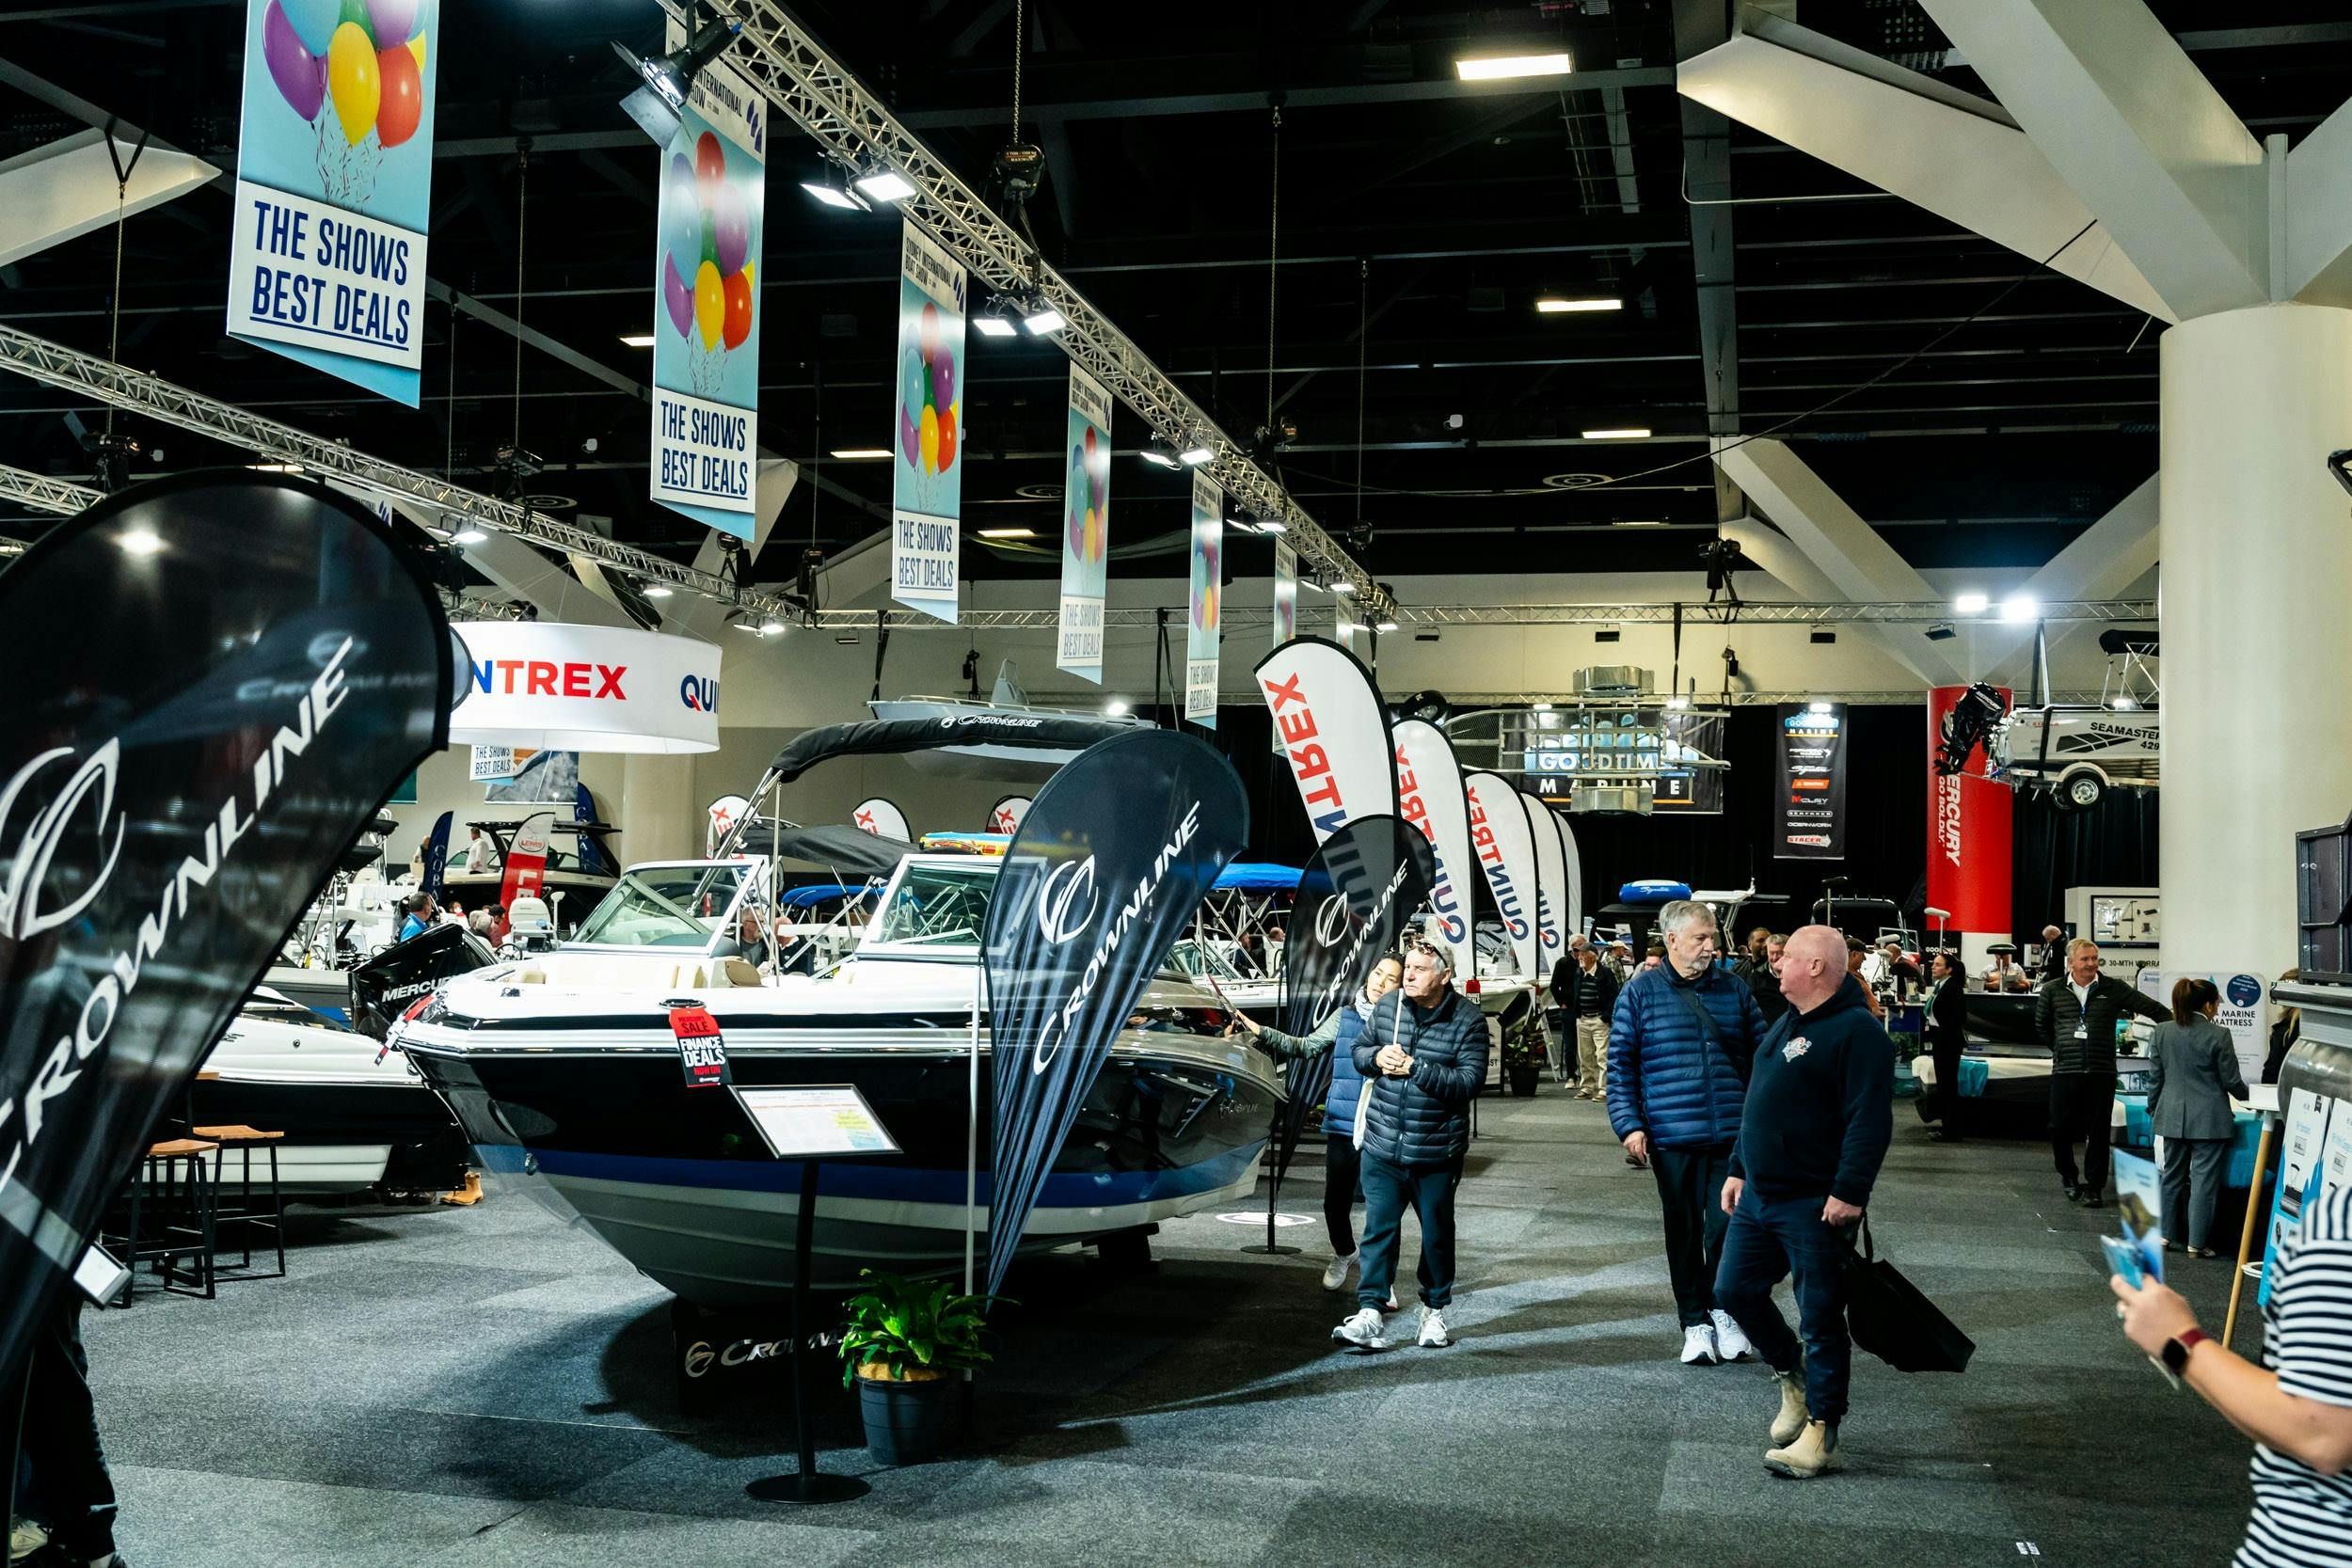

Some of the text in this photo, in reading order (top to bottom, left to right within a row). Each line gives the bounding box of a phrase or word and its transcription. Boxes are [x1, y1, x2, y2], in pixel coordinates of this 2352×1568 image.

[690, 82, 706, 109] HOW
[254, 200, 408, 286] THE SHOWS
[252, 265, 410, 344] BEST DEALS
[661, 400, 746, 451] THE SHOWS
[661, 447, 748, 496] BEST DEALS
[898, 519, 952, 553] THE SHOWS
[898, 556, 954, 588] BEST DEALS
[1065, 604, 1078, 626] THE
[1063, 633, 1082, 656] BEST
[470, 660, 628, 700] NTREX
[680, 674, 720, 715] QUI
[2139, 740, 2160, 751] 429
[475, 760, 512, 775] BEST DEALS
[1938, 776, 1946, 795] GO
[1946, 771, 1962, 868] ERCURY
[431, 845, 446, 901] COBA
[1033, 800, 1200, 1076] CROWNLINE
[1312, 858, 1408, 1029] CROWNLINE
[2135, 959, 2160, 968] WRRA
[681, 1022, 711, 1034] SALE
[2212, 1018, 2253, 1027] MATTRESS
[2221, 1010, 2256, 1019] MARINE
[679, 1036, 723, 1052] FINANCE
[682, 1048, 726, 1068] DEALS
